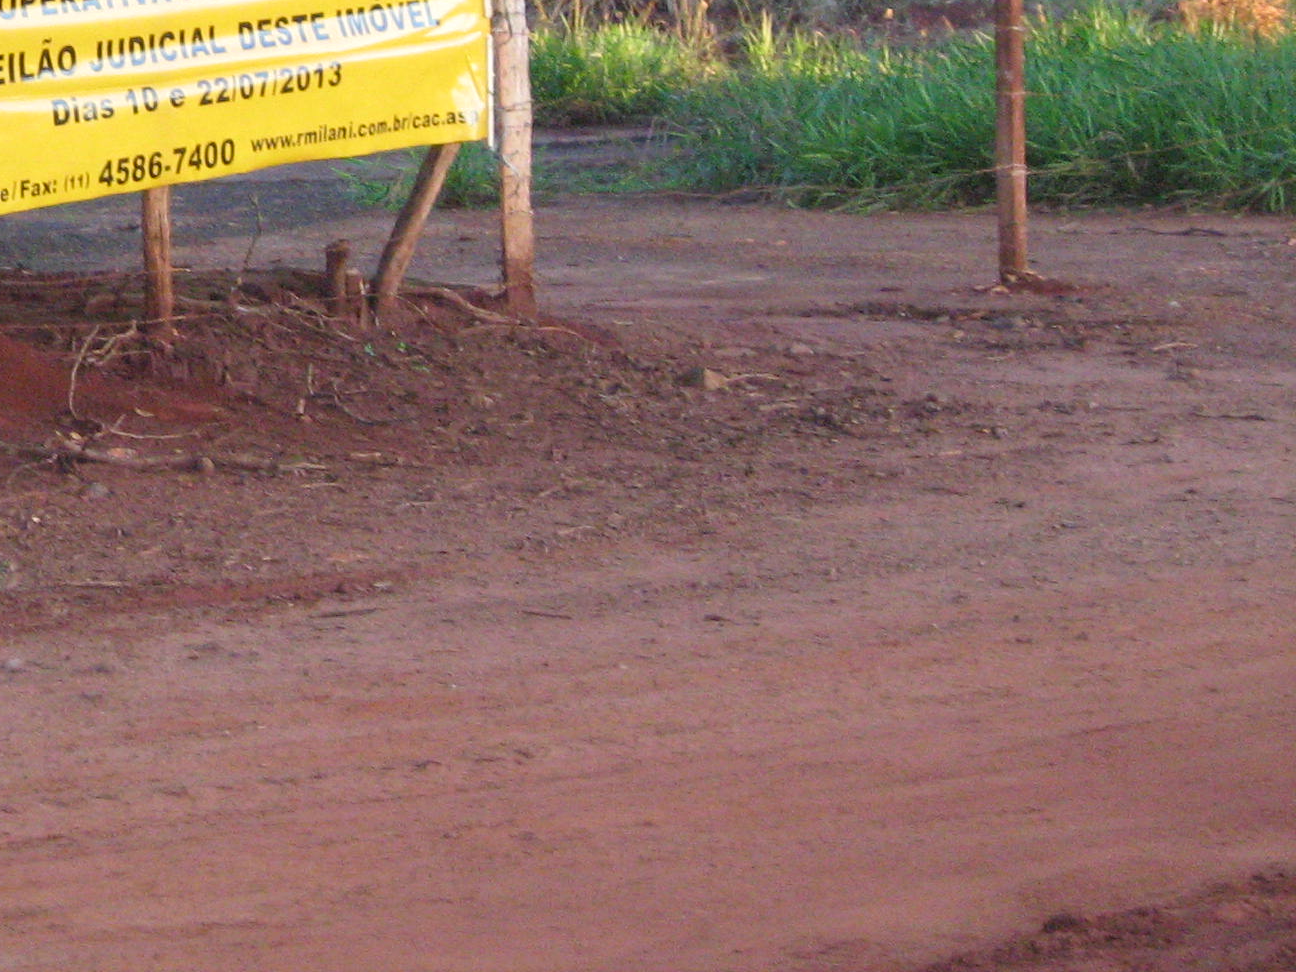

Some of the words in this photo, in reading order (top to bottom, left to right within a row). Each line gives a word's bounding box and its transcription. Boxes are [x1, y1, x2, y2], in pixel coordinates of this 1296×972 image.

[90, 25, 226, 72] JUDICIAL
[238, 12, 330, 50] DESTE
[52, 97, 115, 126] Dias
[126, 86, 158, 114] 10
[169, 88, 187, 107] e
[198, 62, 342, 106] 22/07/2013
[64, 172, 91, 192] (11)
[99, 139, 235, 187] 4586-7400
